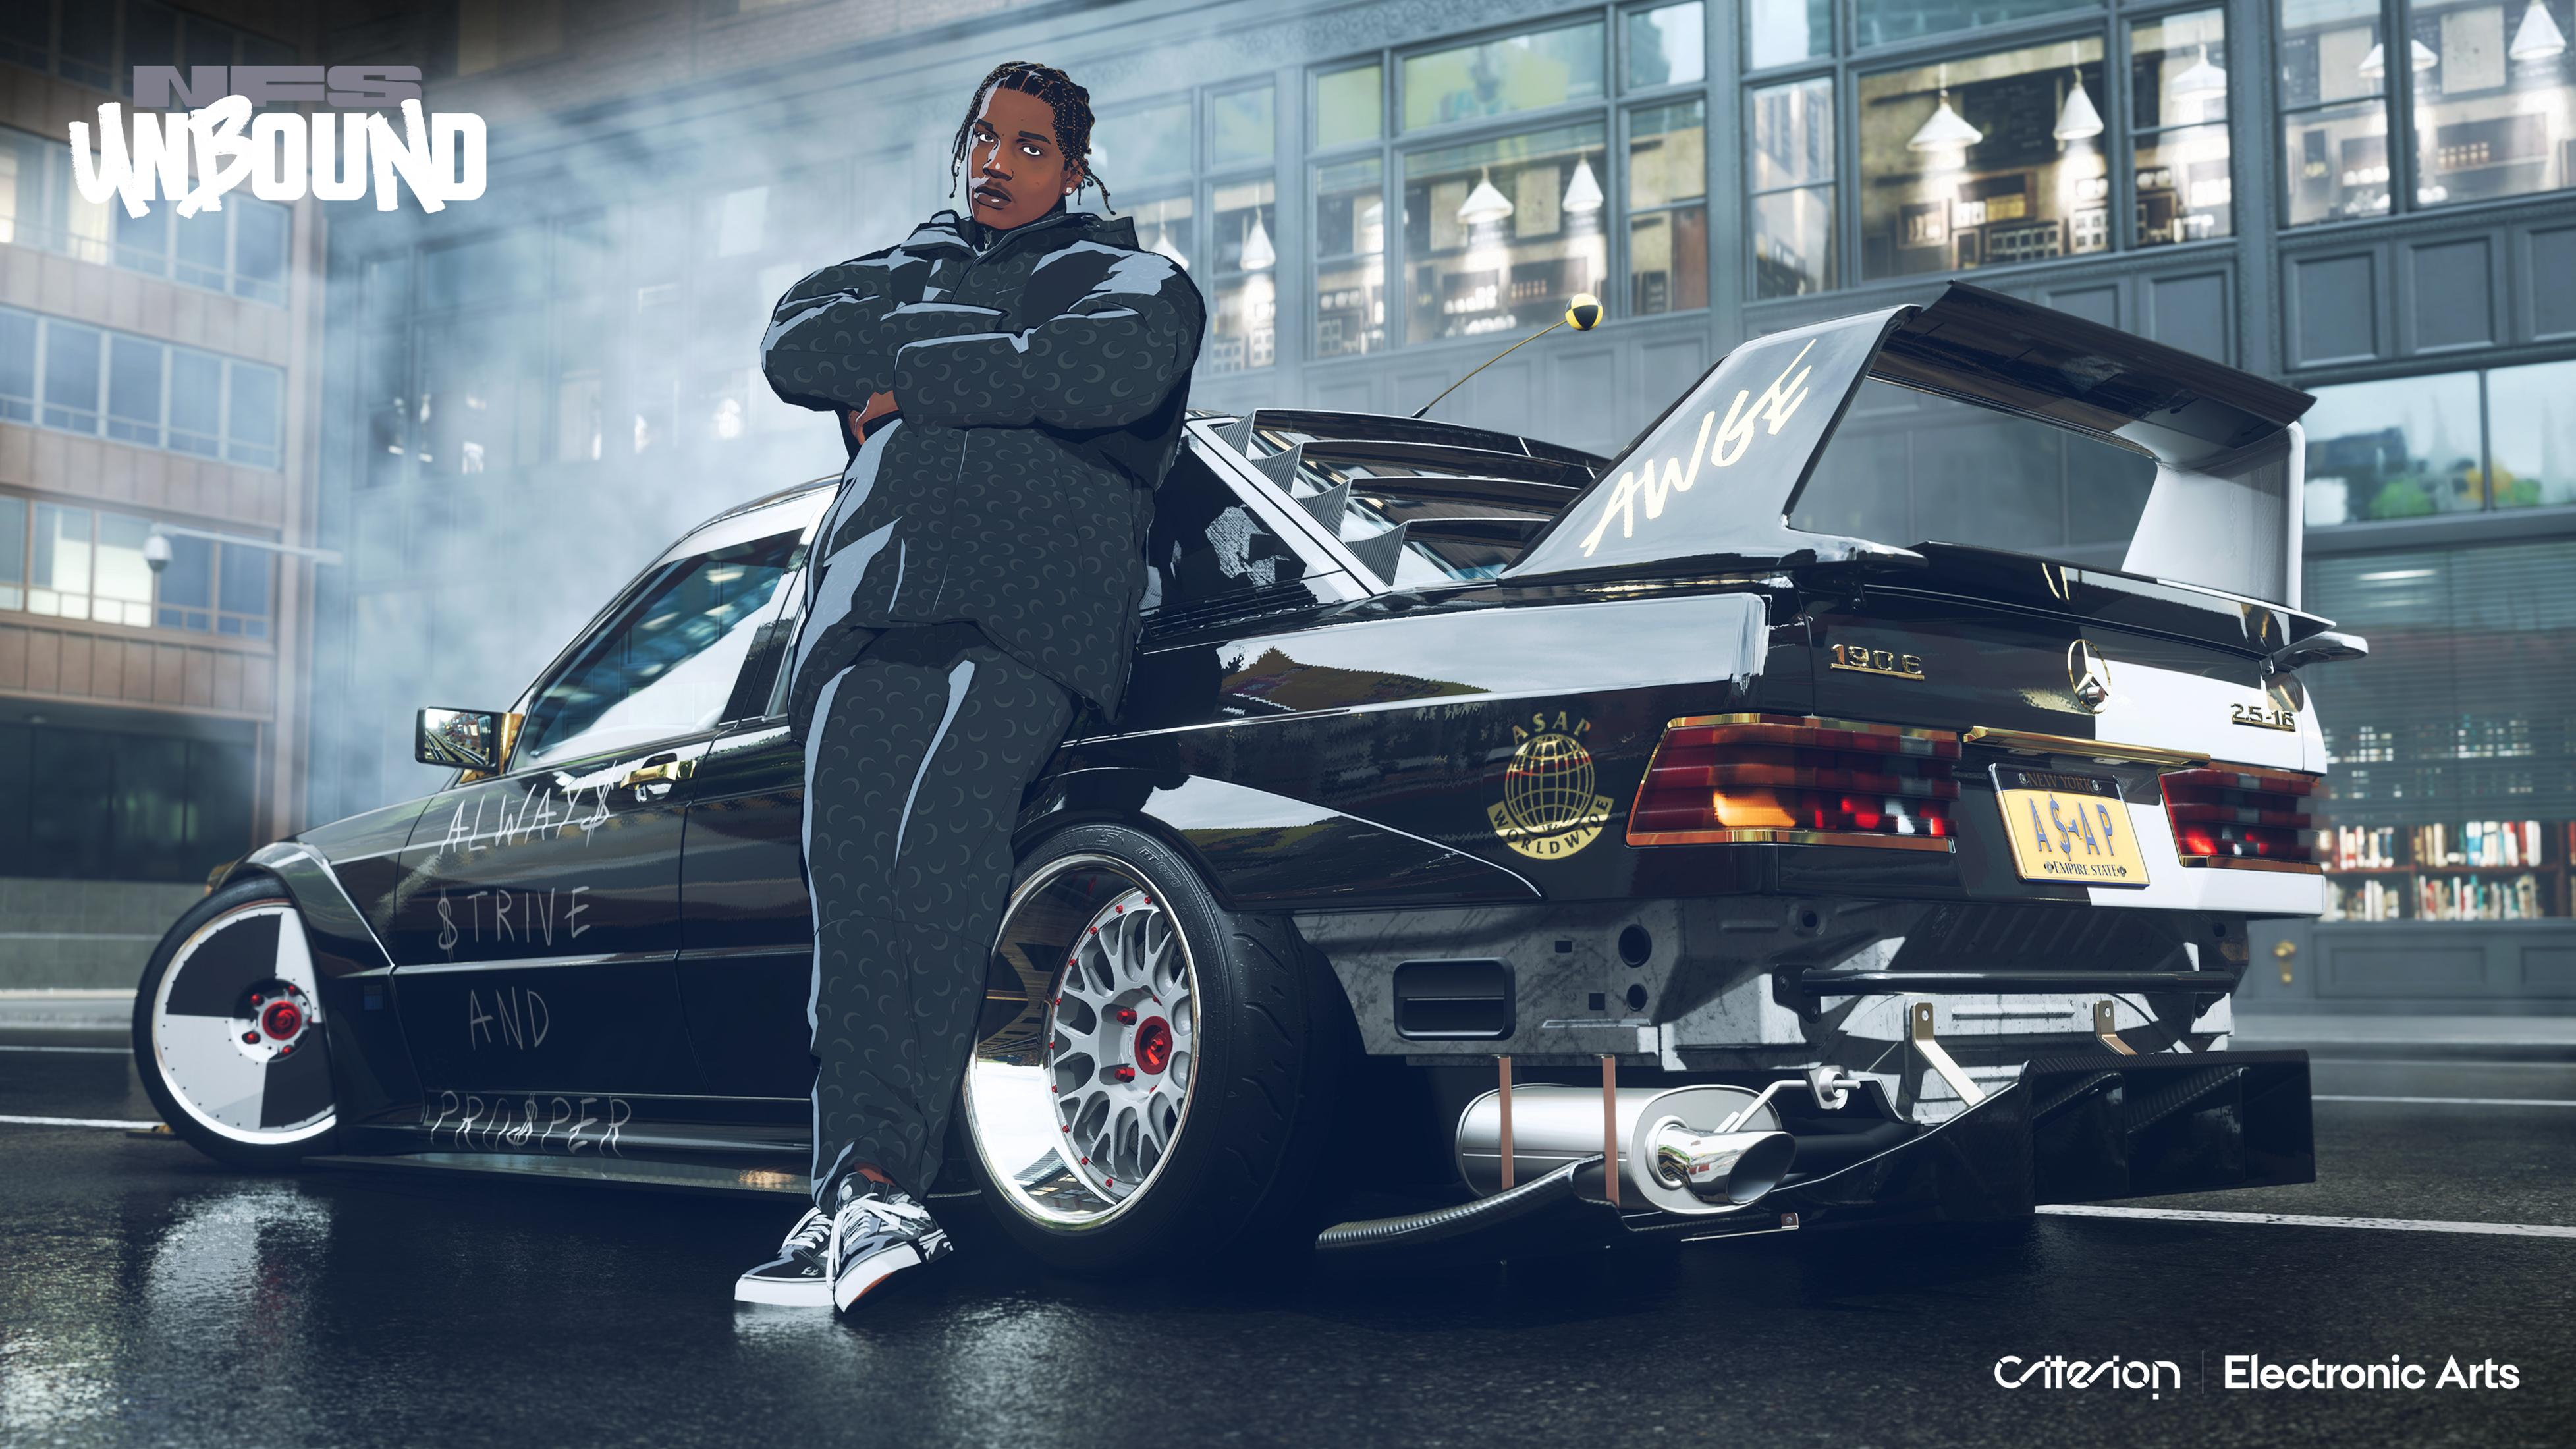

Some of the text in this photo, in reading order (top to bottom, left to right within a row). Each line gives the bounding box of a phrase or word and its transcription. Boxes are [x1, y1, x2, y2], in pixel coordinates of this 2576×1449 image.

[1830, 643, 1922, 674] 190 E
[2025, 771, 2095, 792] NEW YORK
[1493, 798, 1609, 854] WORLDWIDE
[2053, 861, 2119, 877] EMPIRE STATE
[470, 986, 549, 1051] AND
